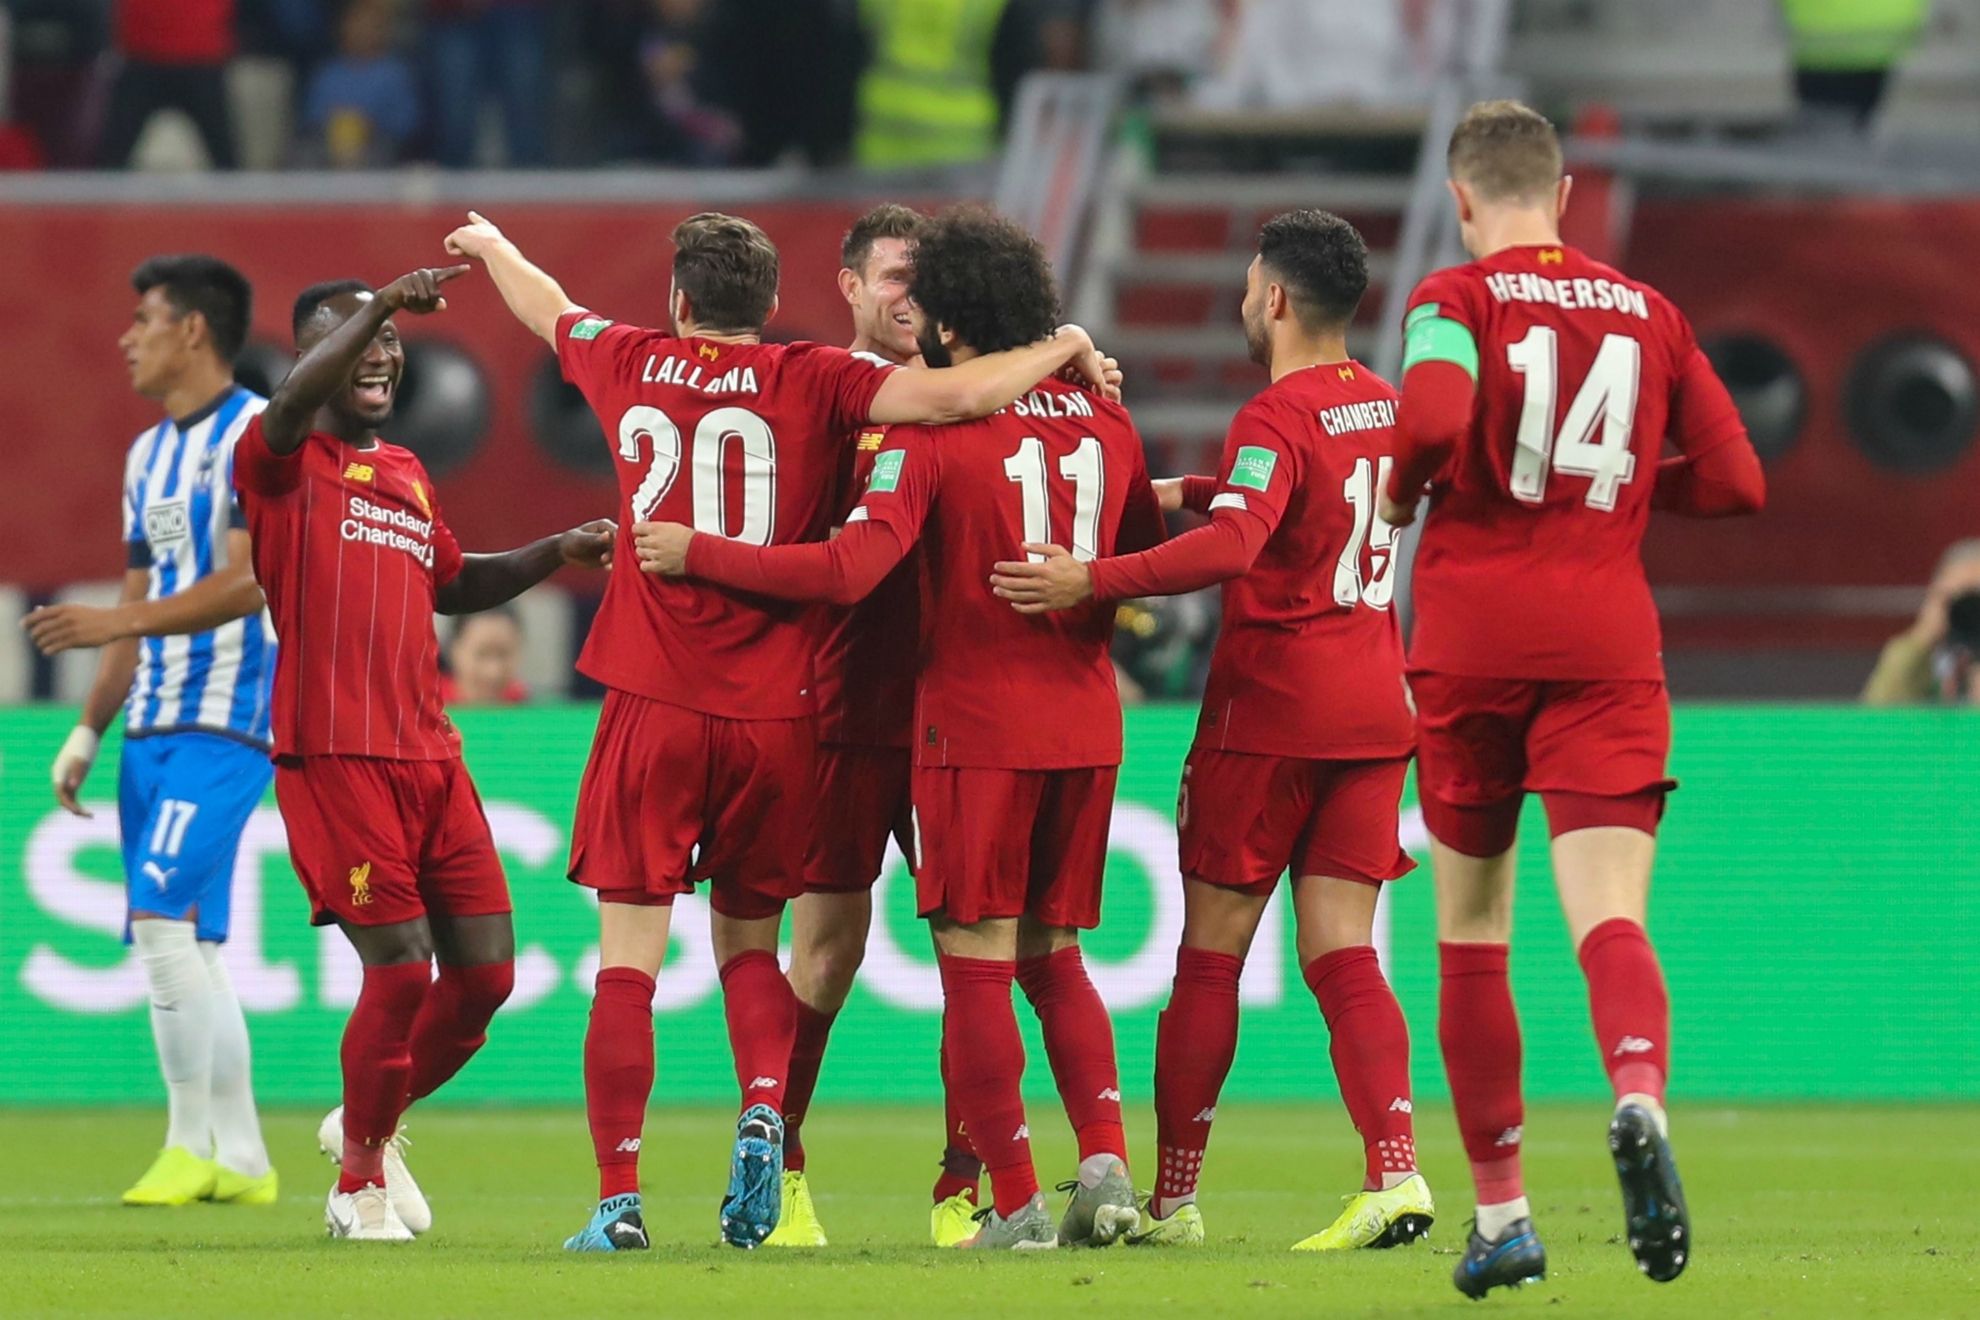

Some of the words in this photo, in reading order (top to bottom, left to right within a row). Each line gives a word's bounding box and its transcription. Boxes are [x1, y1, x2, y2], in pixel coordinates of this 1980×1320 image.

[1485, 271, 1649, 320] HENDERSON
[642, 354, 758, 394] LALLANA
[1014, 390, 1094, 418] SALAH
[1507, 325, 1641, 512] 14
[618, 404, 776, 547] 20
[1003, 436, 1105, 563] 11
[340, 519, 429, 562] Chartered
[349, 496, 432, 539] Standard
[1333, 456, 1401, 611] 15
[149, 798, 199, 858] 17
